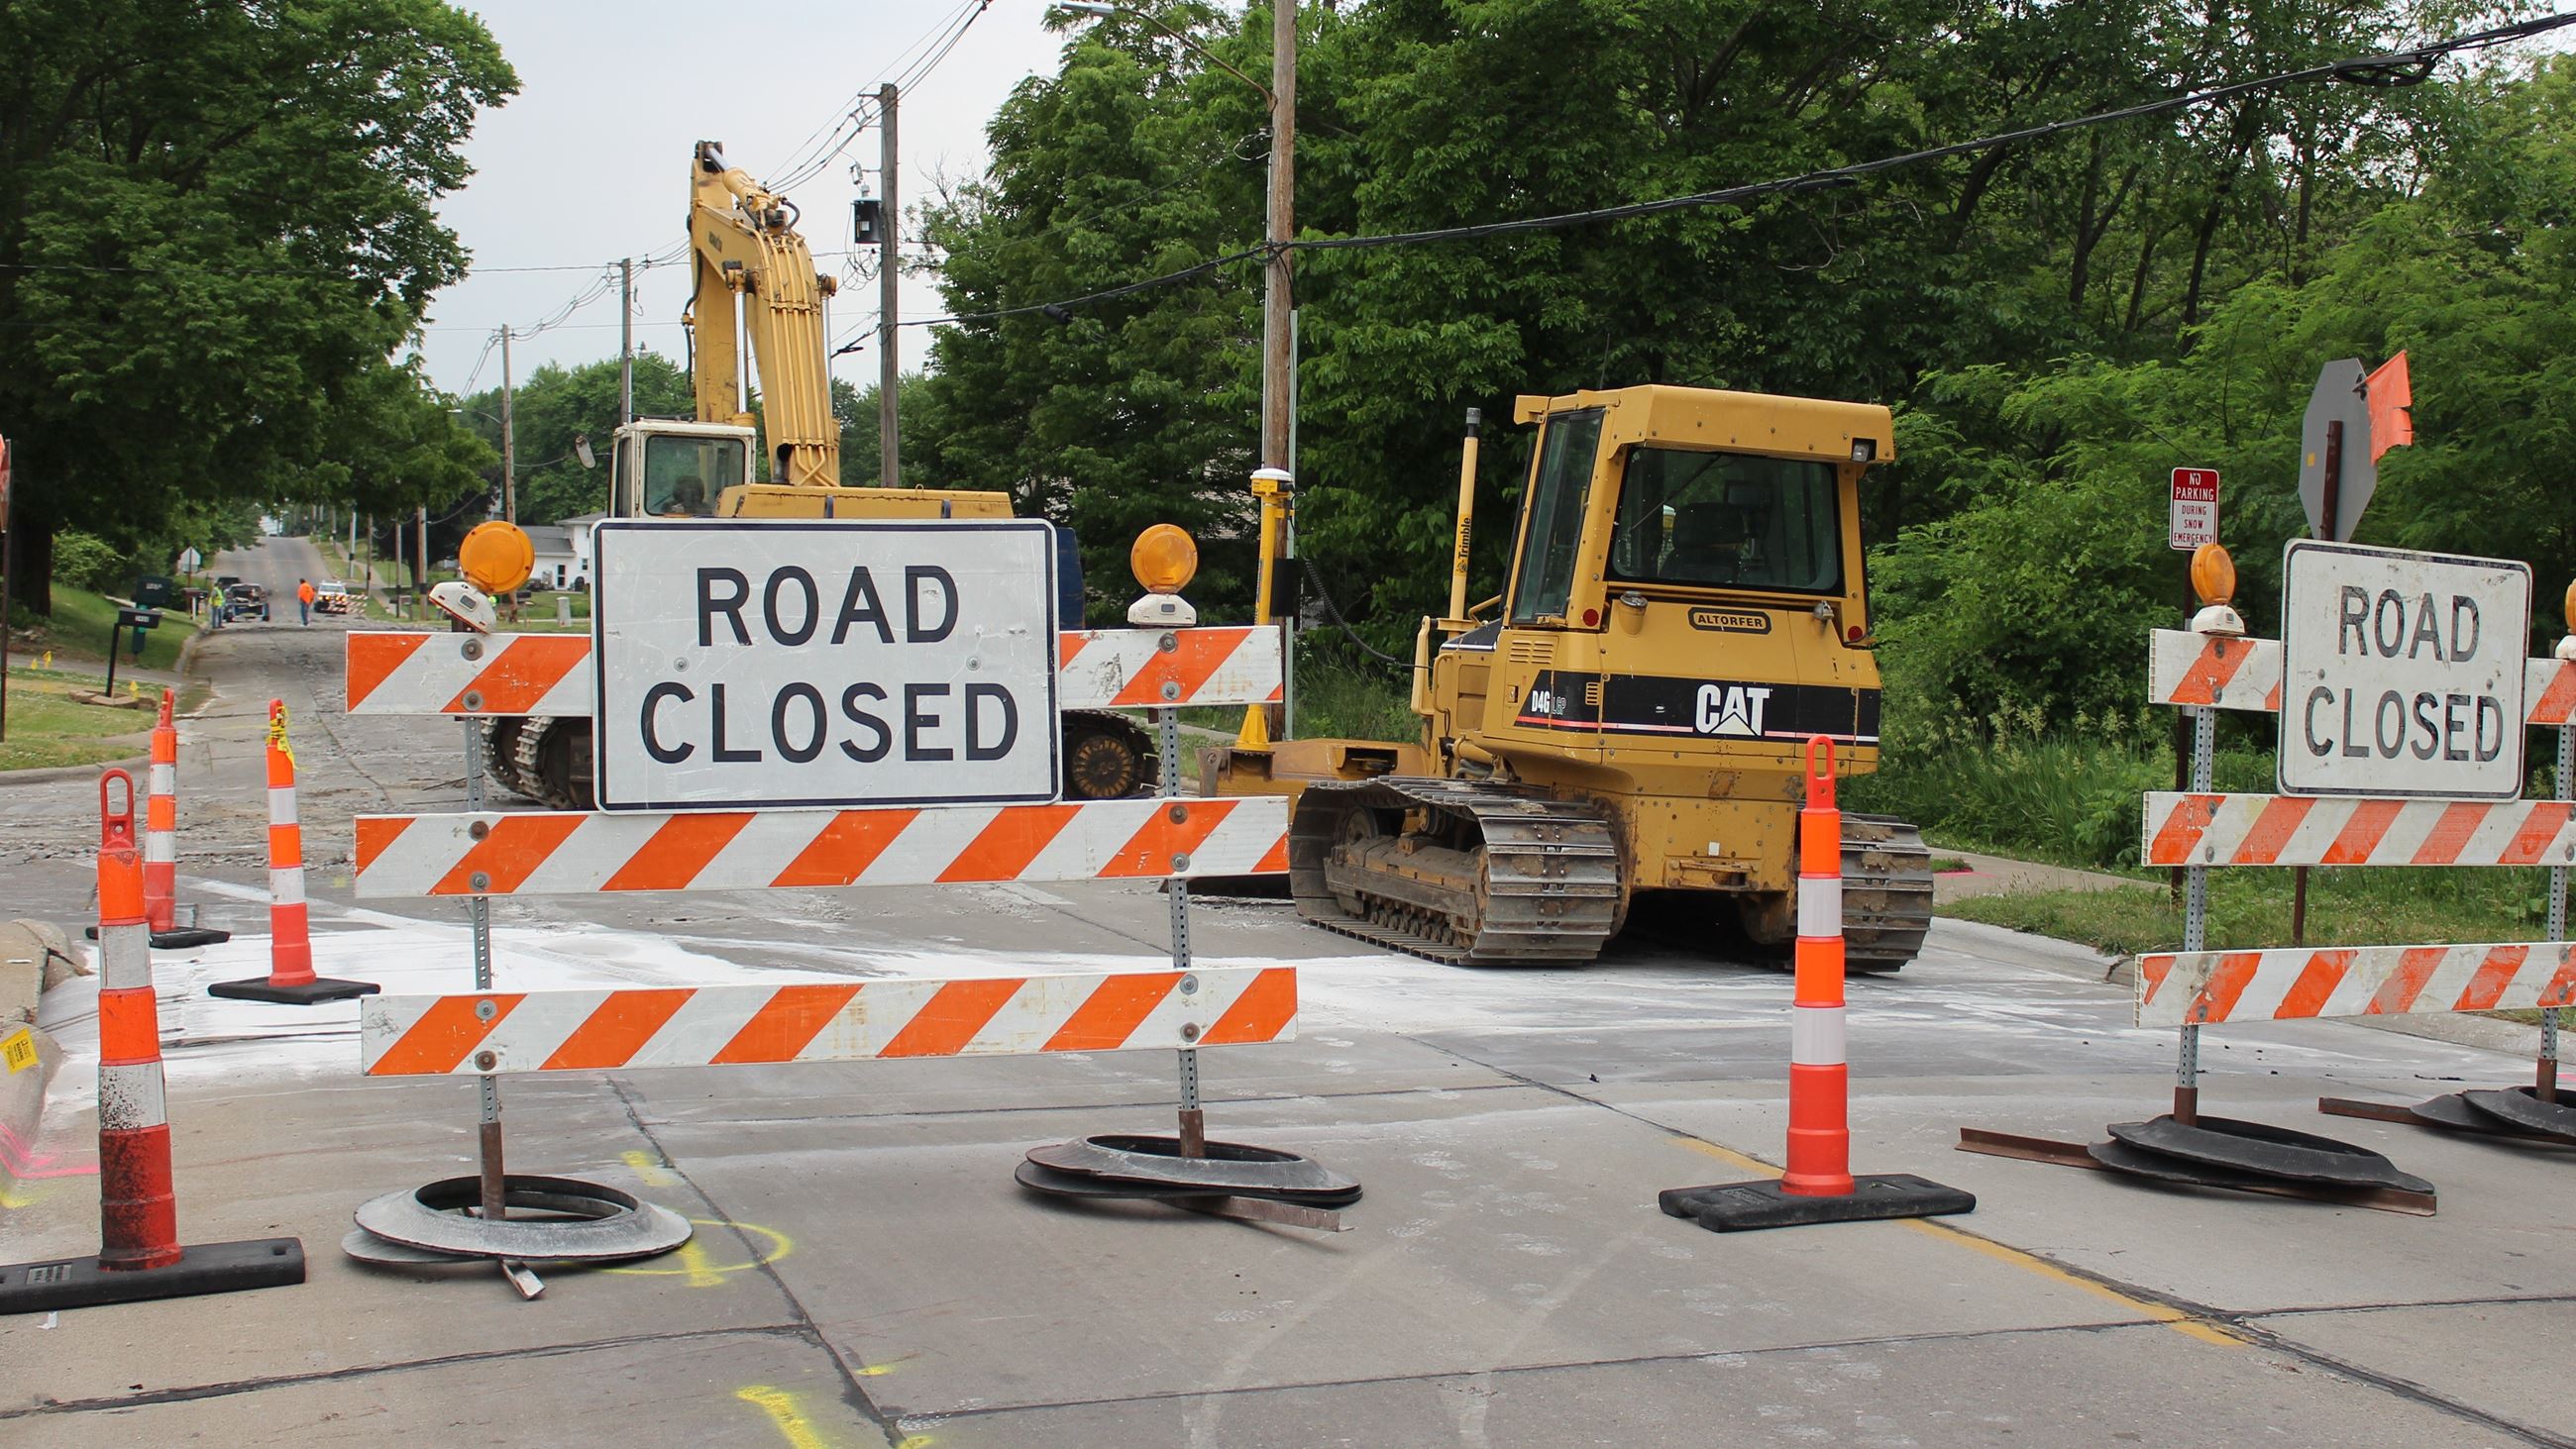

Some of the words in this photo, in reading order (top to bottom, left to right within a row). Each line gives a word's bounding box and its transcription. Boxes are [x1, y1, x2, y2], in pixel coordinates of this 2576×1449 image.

[2189, 472, 2201, 485] NO
[2176, 486, 2214, 500] PARKING
[2182, 505, 2207, 515] DURING
[2184, 519, 2203, 529] SNOW
[1458, 517, 1471, 559] Trimble
[2174, 533, 2213, 544] EMERGENCY
[698, 566, 959, 647] ROAD
[1697, 615, 1763, 627] ALTORFER
[2338, 585, 2479, 663] ROAD
[1531, 690, 1551, 713] D4G
[1695, 683, 1771, 736] CAT
[640, 681, 1019, 764] CLOSED
[2305, 685, 2504, 763] CLOSED
